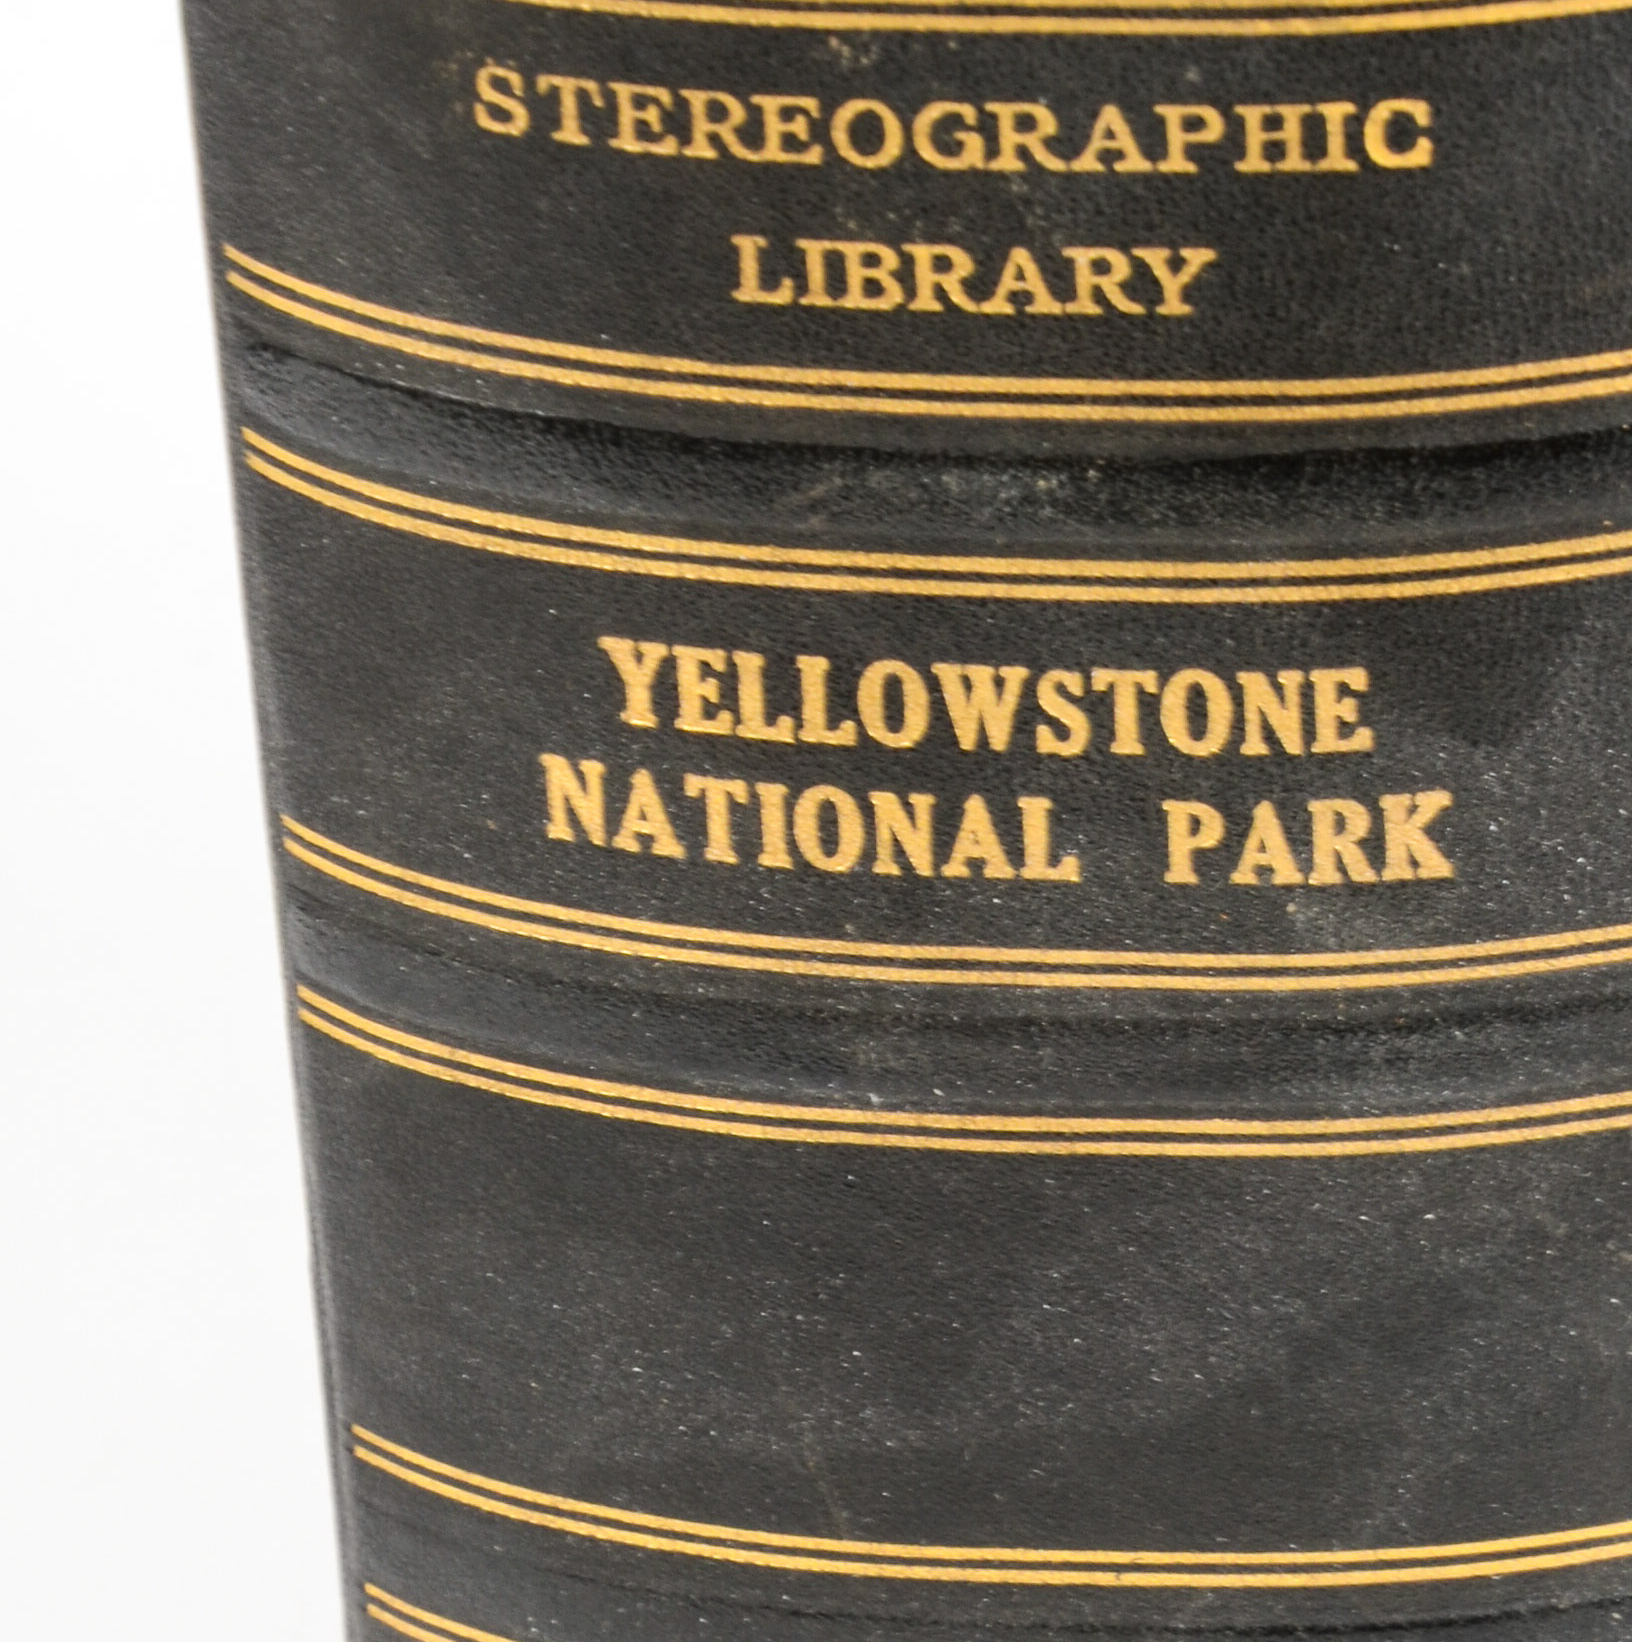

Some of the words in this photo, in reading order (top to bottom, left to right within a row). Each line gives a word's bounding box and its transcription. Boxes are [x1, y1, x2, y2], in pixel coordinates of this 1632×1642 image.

[474, 60, 1434, 174] STEREOGRAPHIC
[731, 234, 1217, 316] LIBRARY
[597, 635, 1375, 757] YELLOWSTONE
[542, 751, 1083, 883] NATIONAL
[1161, 789, 1455, 886] PARK
